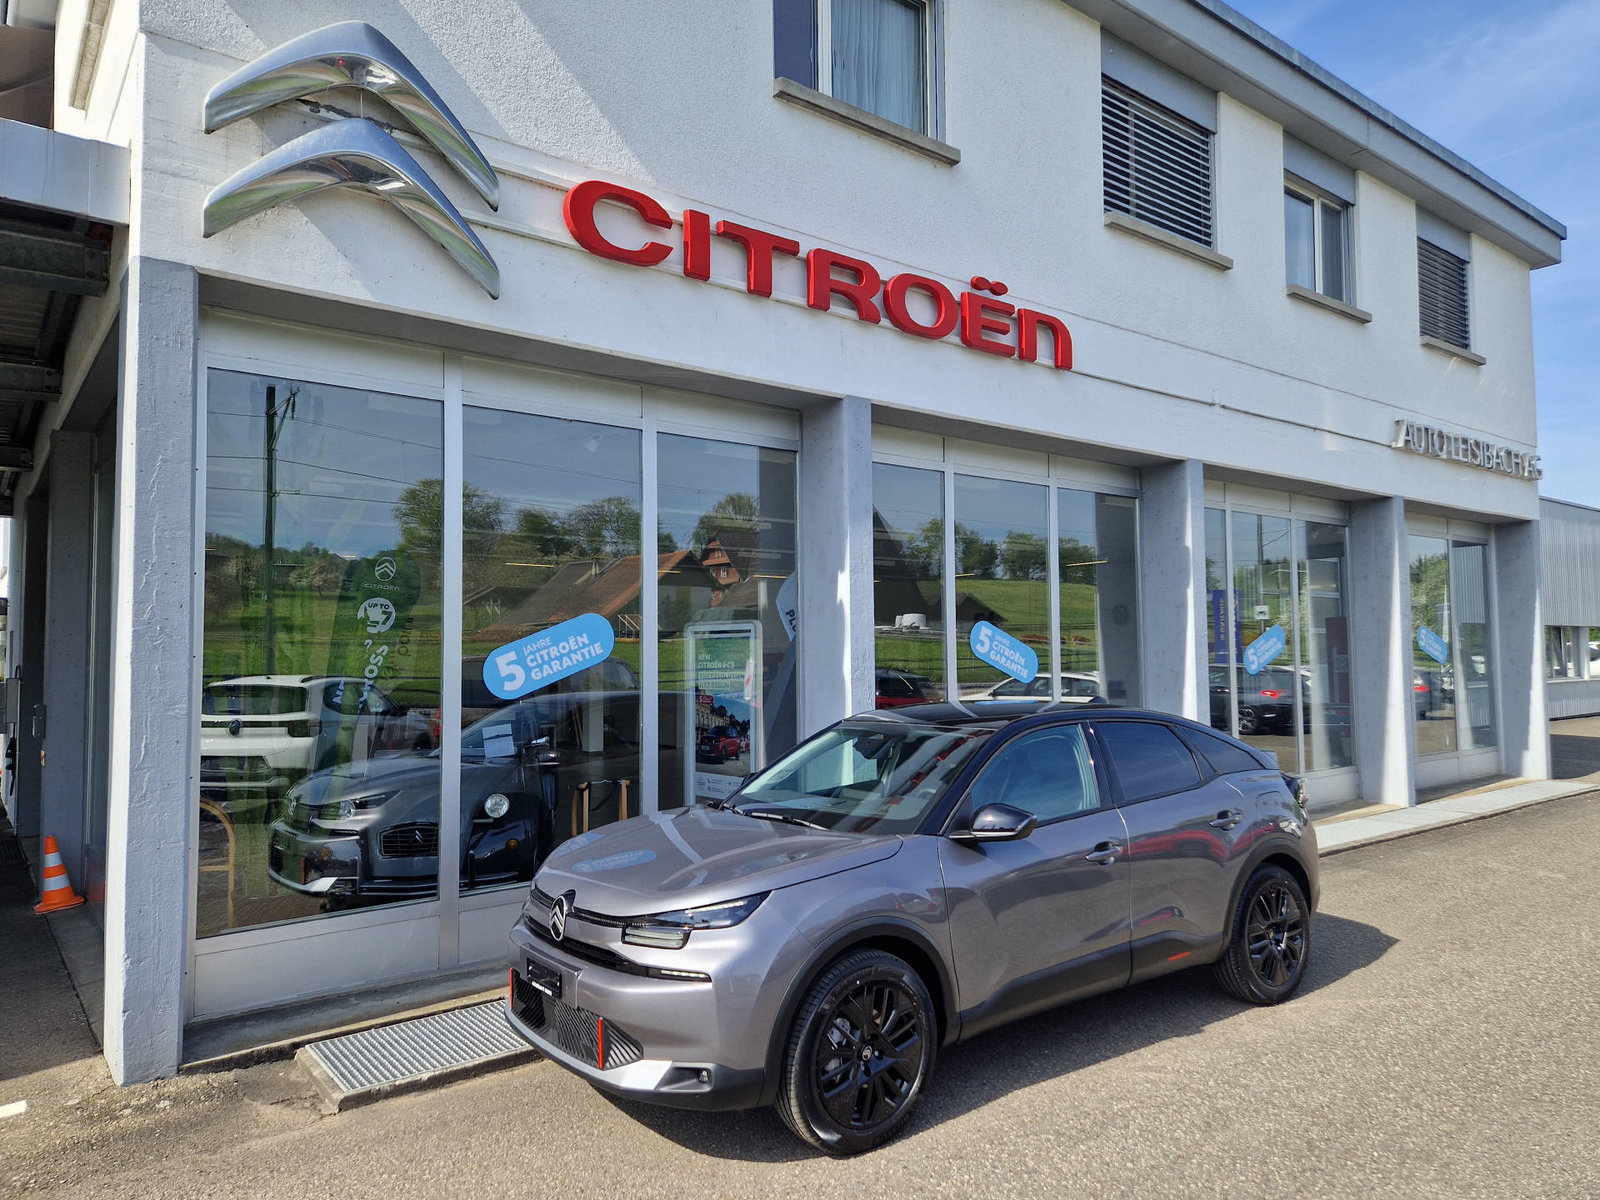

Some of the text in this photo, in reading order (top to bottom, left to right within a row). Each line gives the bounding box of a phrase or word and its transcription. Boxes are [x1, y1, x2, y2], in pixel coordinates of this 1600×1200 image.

[563, 180, 1073, 370] CITROËN
[1391, 419, 1448, 458] AUTO
[523, 637, 552, 656] JAHRE
[526, 633, 589, 667] CITROËN
[976, 626, 992, 653] 5
[992, 641, 1026, 665] CITROËN
[495, 651, 525, 691] 5
[531, 642, 603, 680] GARANTIE
[990, 650, 1029, 678] GARANTIE
[1248, 648, 1258, 670] 5
